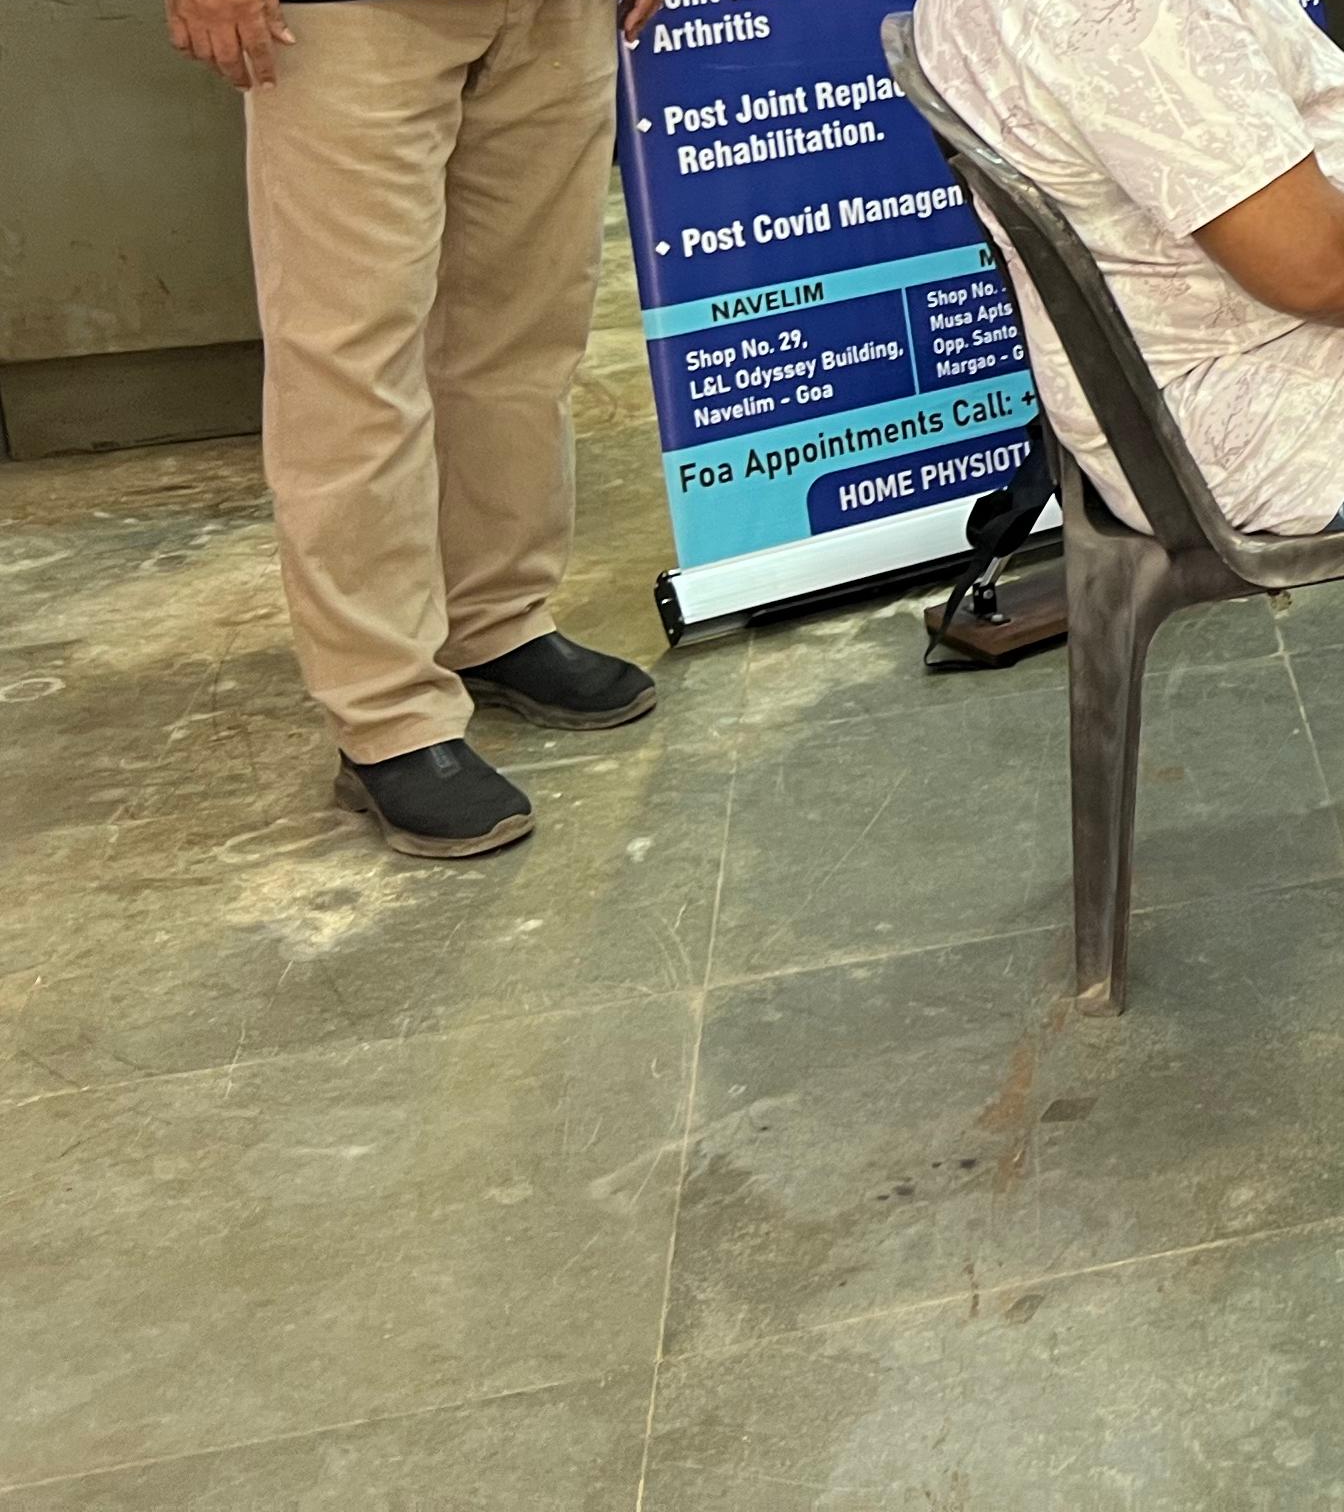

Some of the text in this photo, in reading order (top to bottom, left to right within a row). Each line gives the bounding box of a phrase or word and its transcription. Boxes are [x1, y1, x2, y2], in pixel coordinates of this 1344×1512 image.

[653, 11, 771, 54] Arthritis
[664, 99, 728, 135] Post
[735, 86, 809, 124] Joint
[677, 120, 885, 176] Rehabilitation.
[681, 220, 746, 258] Post
[753, 203, 832, 244] Covid
[711, 281, 825, 322] NAVELIM
[927, 281, 998, 308] Shop No.
[930, 311, 973, 332] Musa
[933, 325, 1018, 356] Opp. Santo
[686, 329, 809, 372] Shop No. 29,
[690, 340, 904, 400] L&L Odyssey Building,
[936, 354, 996, 378] Margao
[693, 395, 775, 429] Navelim
[796, 383, 834, 404] Goa
[680, 463, 734, 493] Foa
[745, 409, 944, 480] Appointments
[952, 390, 1014, 427] Call:
[838, 469, 914, 512] HOME
